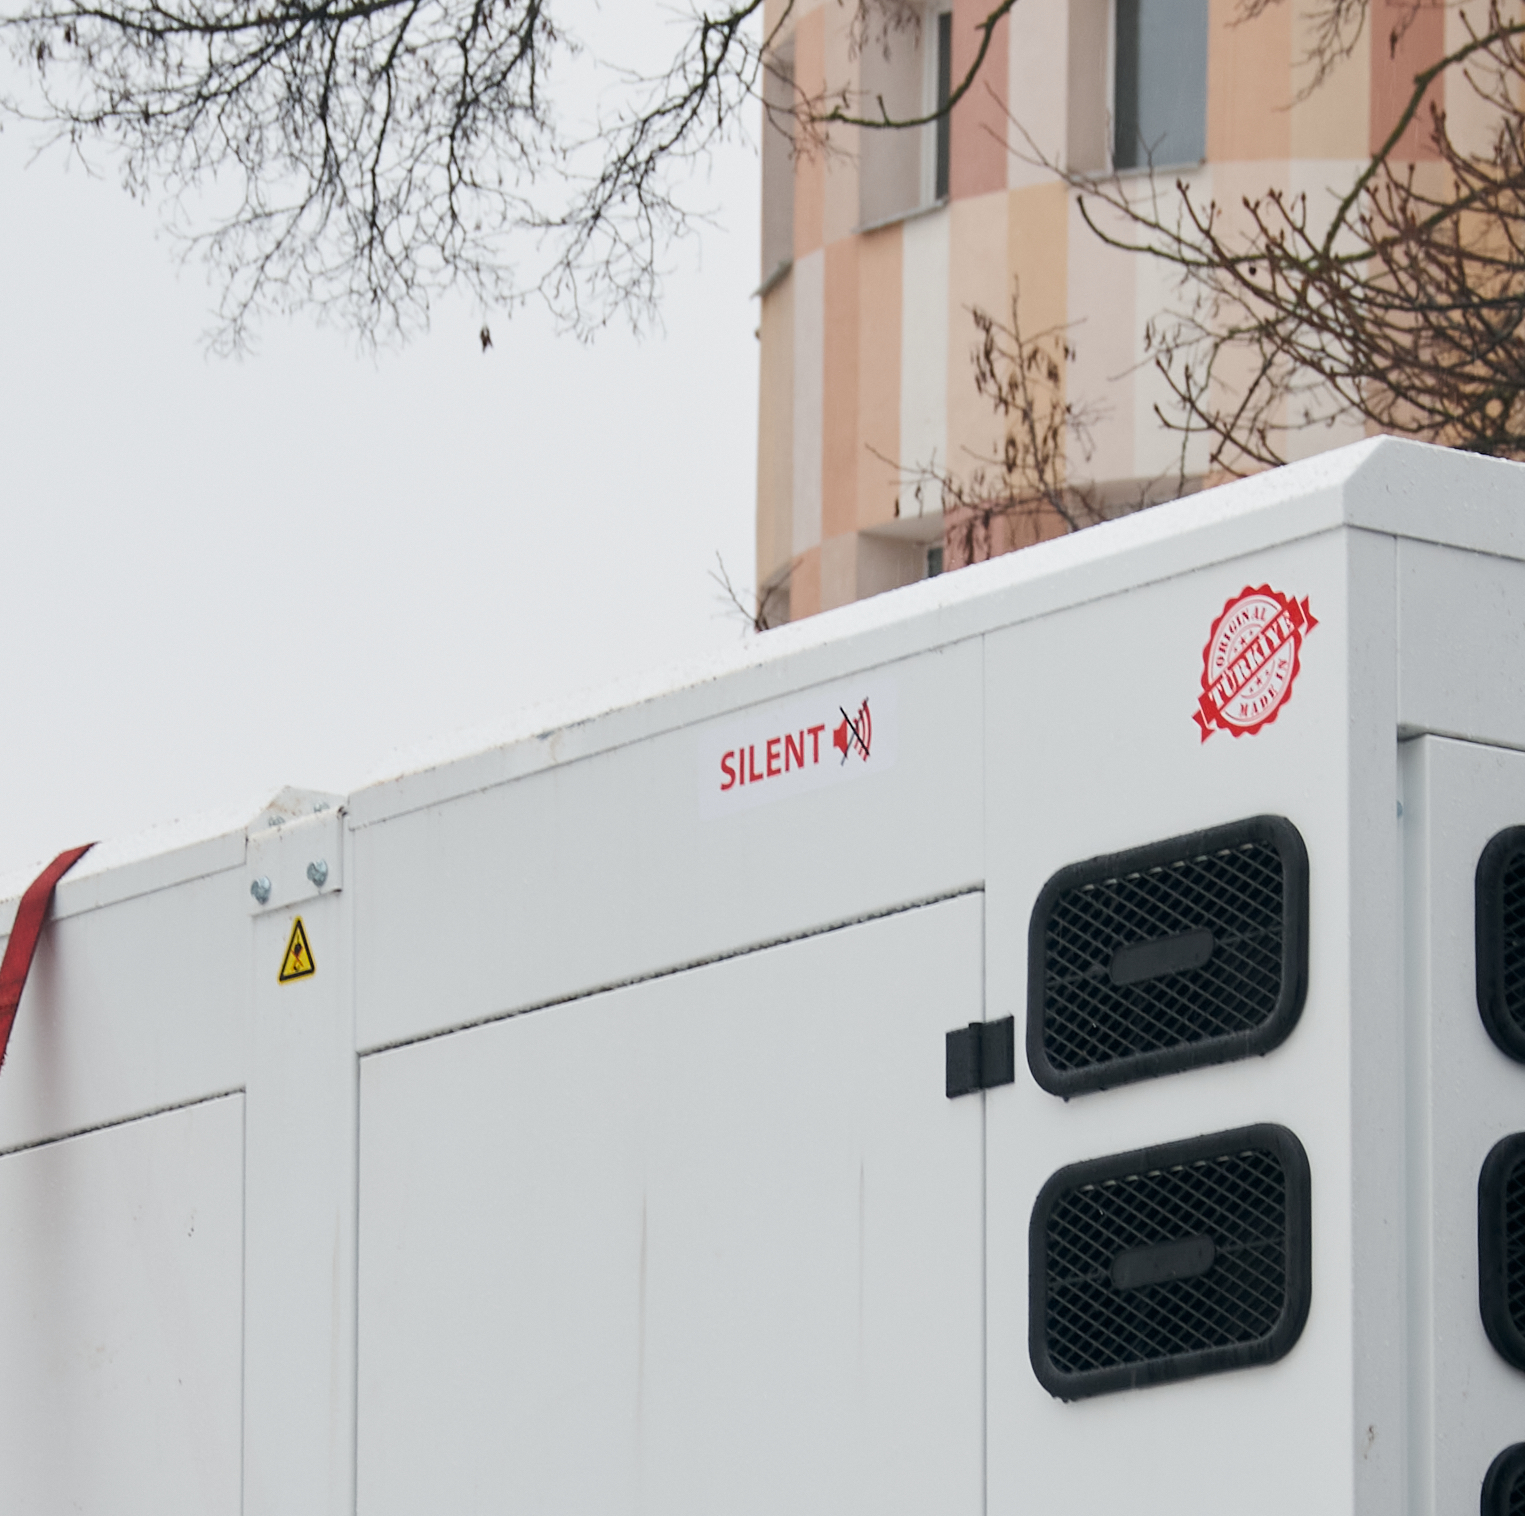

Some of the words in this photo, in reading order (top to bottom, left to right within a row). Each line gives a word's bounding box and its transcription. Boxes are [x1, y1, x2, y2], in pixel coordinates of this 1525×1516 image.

[1216, 606, 1266, 667] ORIGINAL
[1240, 685, 1277, 717] MADE
[1276, 659, 1288, 681] IN
[720, 724, 825, 791] SILENT
